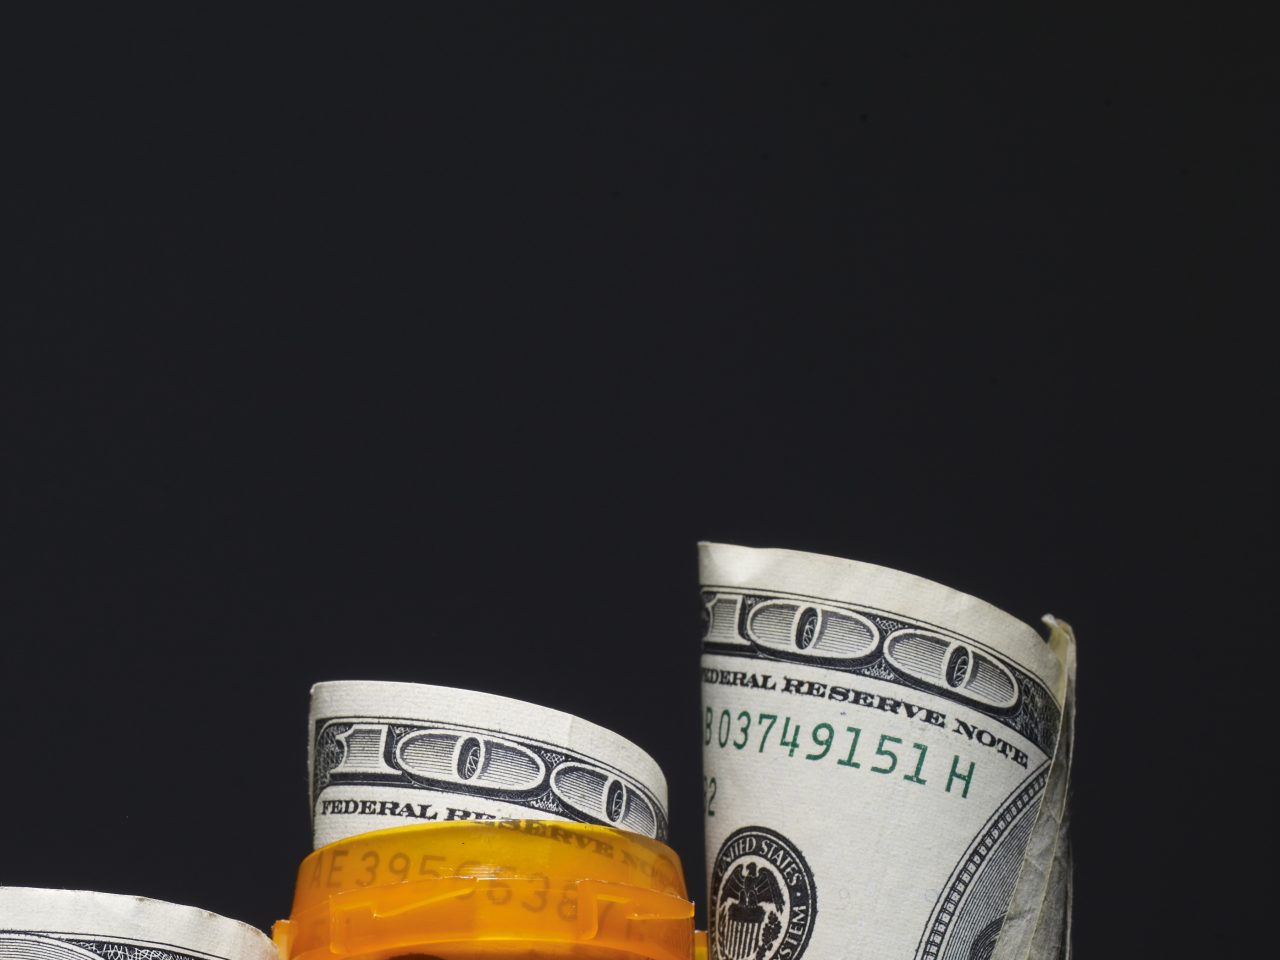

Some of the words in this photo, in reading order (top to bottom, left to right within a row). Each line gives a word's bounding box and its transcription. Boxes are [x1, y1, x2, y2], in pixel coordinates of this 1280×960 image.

[703, 668, 776, 690] EDERAL
[783, 677, 947, 728] RESERVE
[953, 718, 1028, 770] NOTE
[704, 778, 717, 817] 2
[945, 755, 976, 798] H
[321, 800, 438, 820] FEDERAL
[443, 808, 614, 861] RESERVE
[760, 840, 802, 886] STATES
